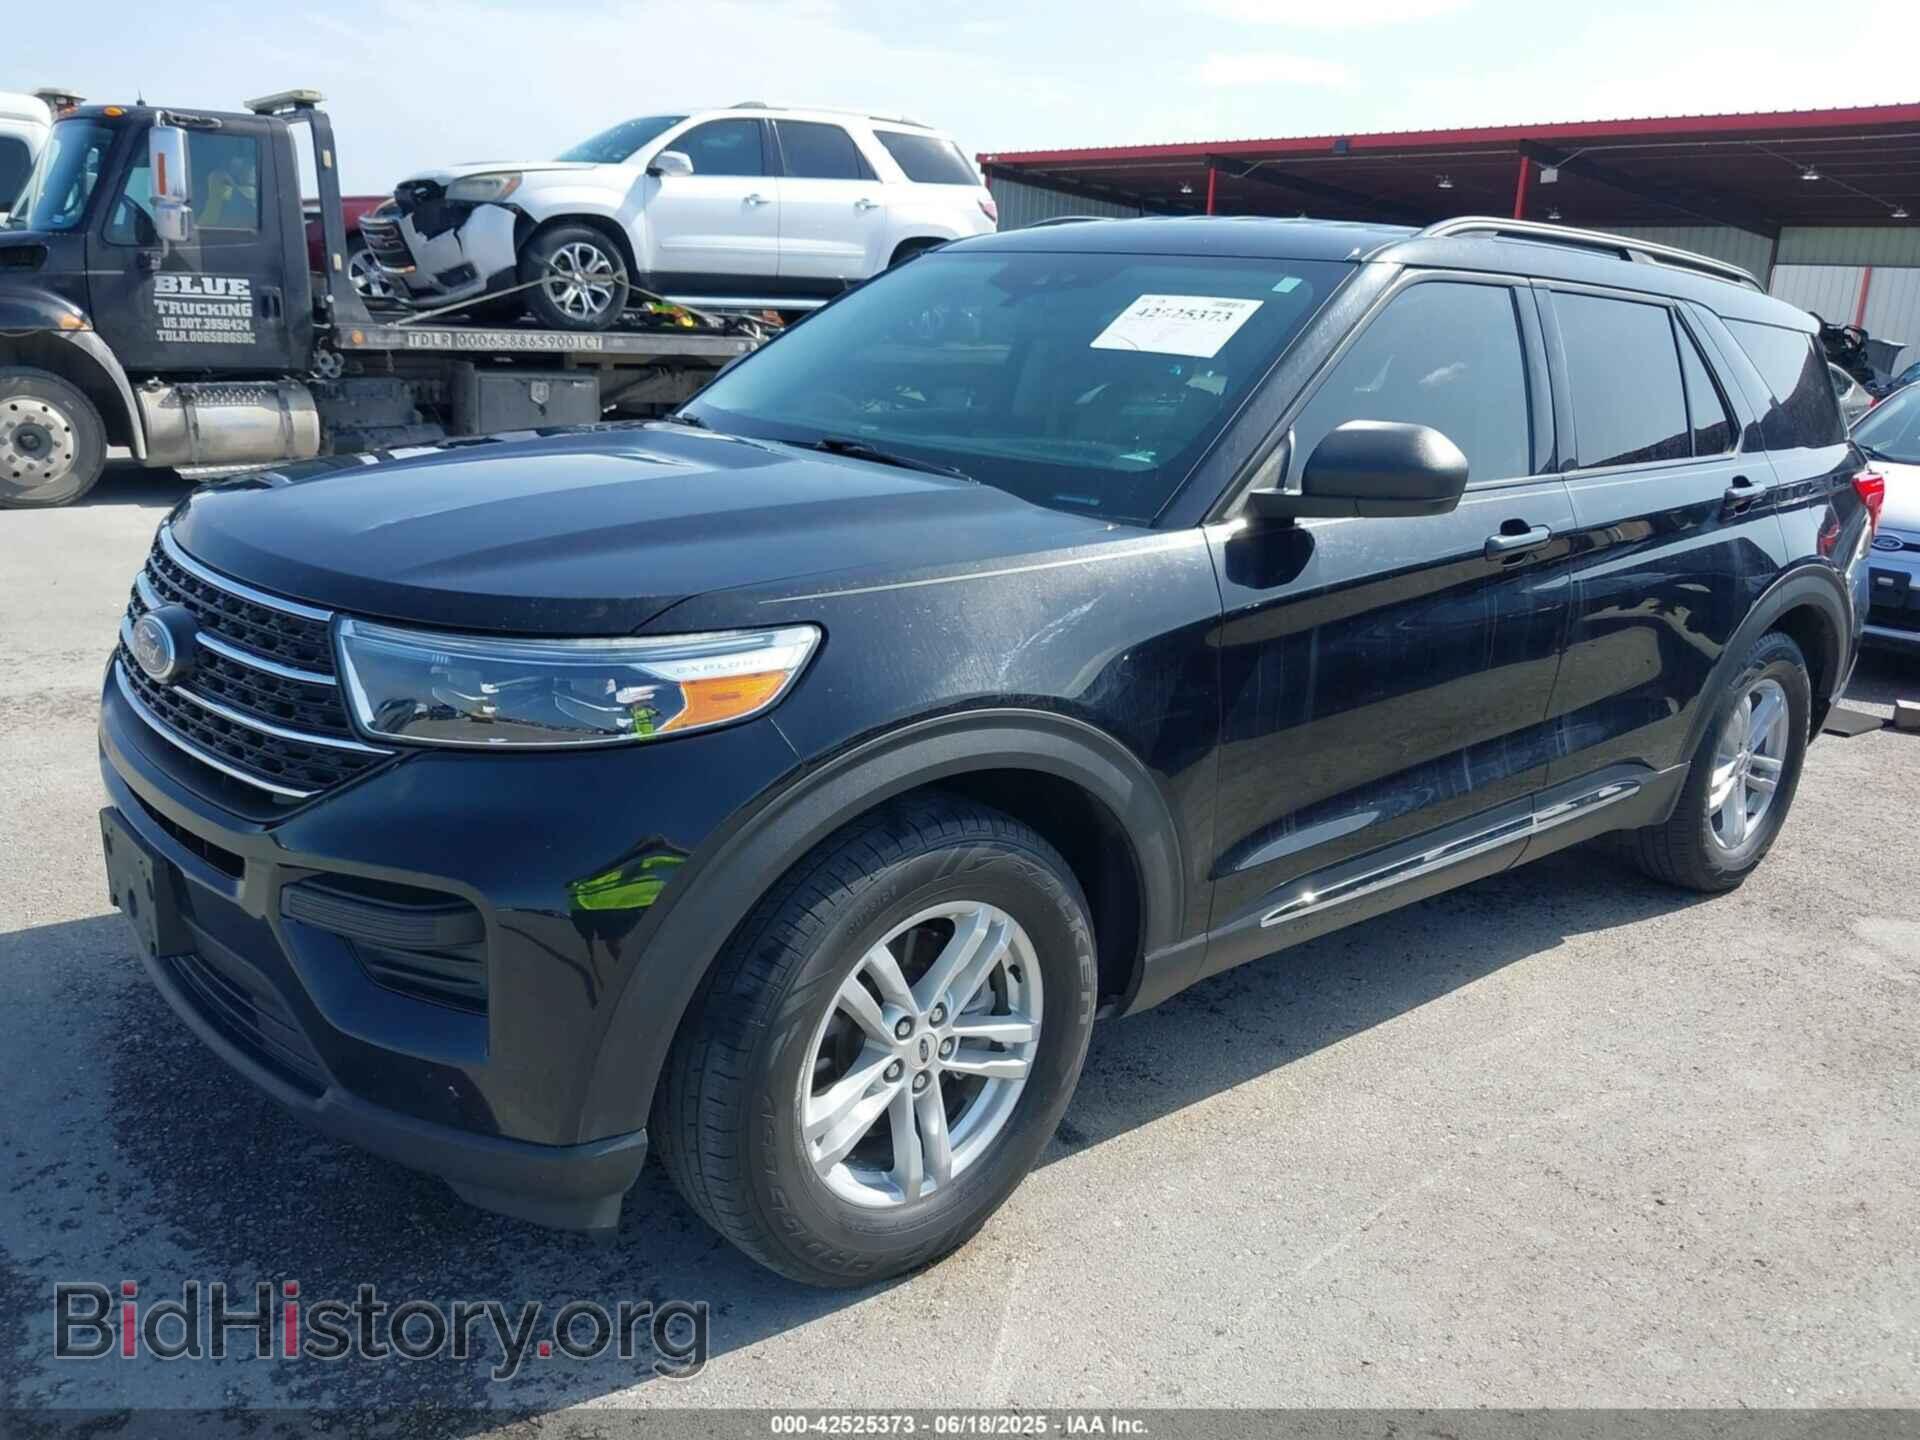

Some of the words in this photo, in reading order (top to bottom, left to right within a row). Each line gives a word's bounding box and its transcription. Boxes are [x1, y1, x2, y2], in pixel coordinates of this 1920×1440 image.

[154, 275, 251, 296] BLUE
[153, 300, 253, 317] TRUCKING
[409, 333, 449, 346] TDLR
[676, 658, 762, 675] EXPLOR
